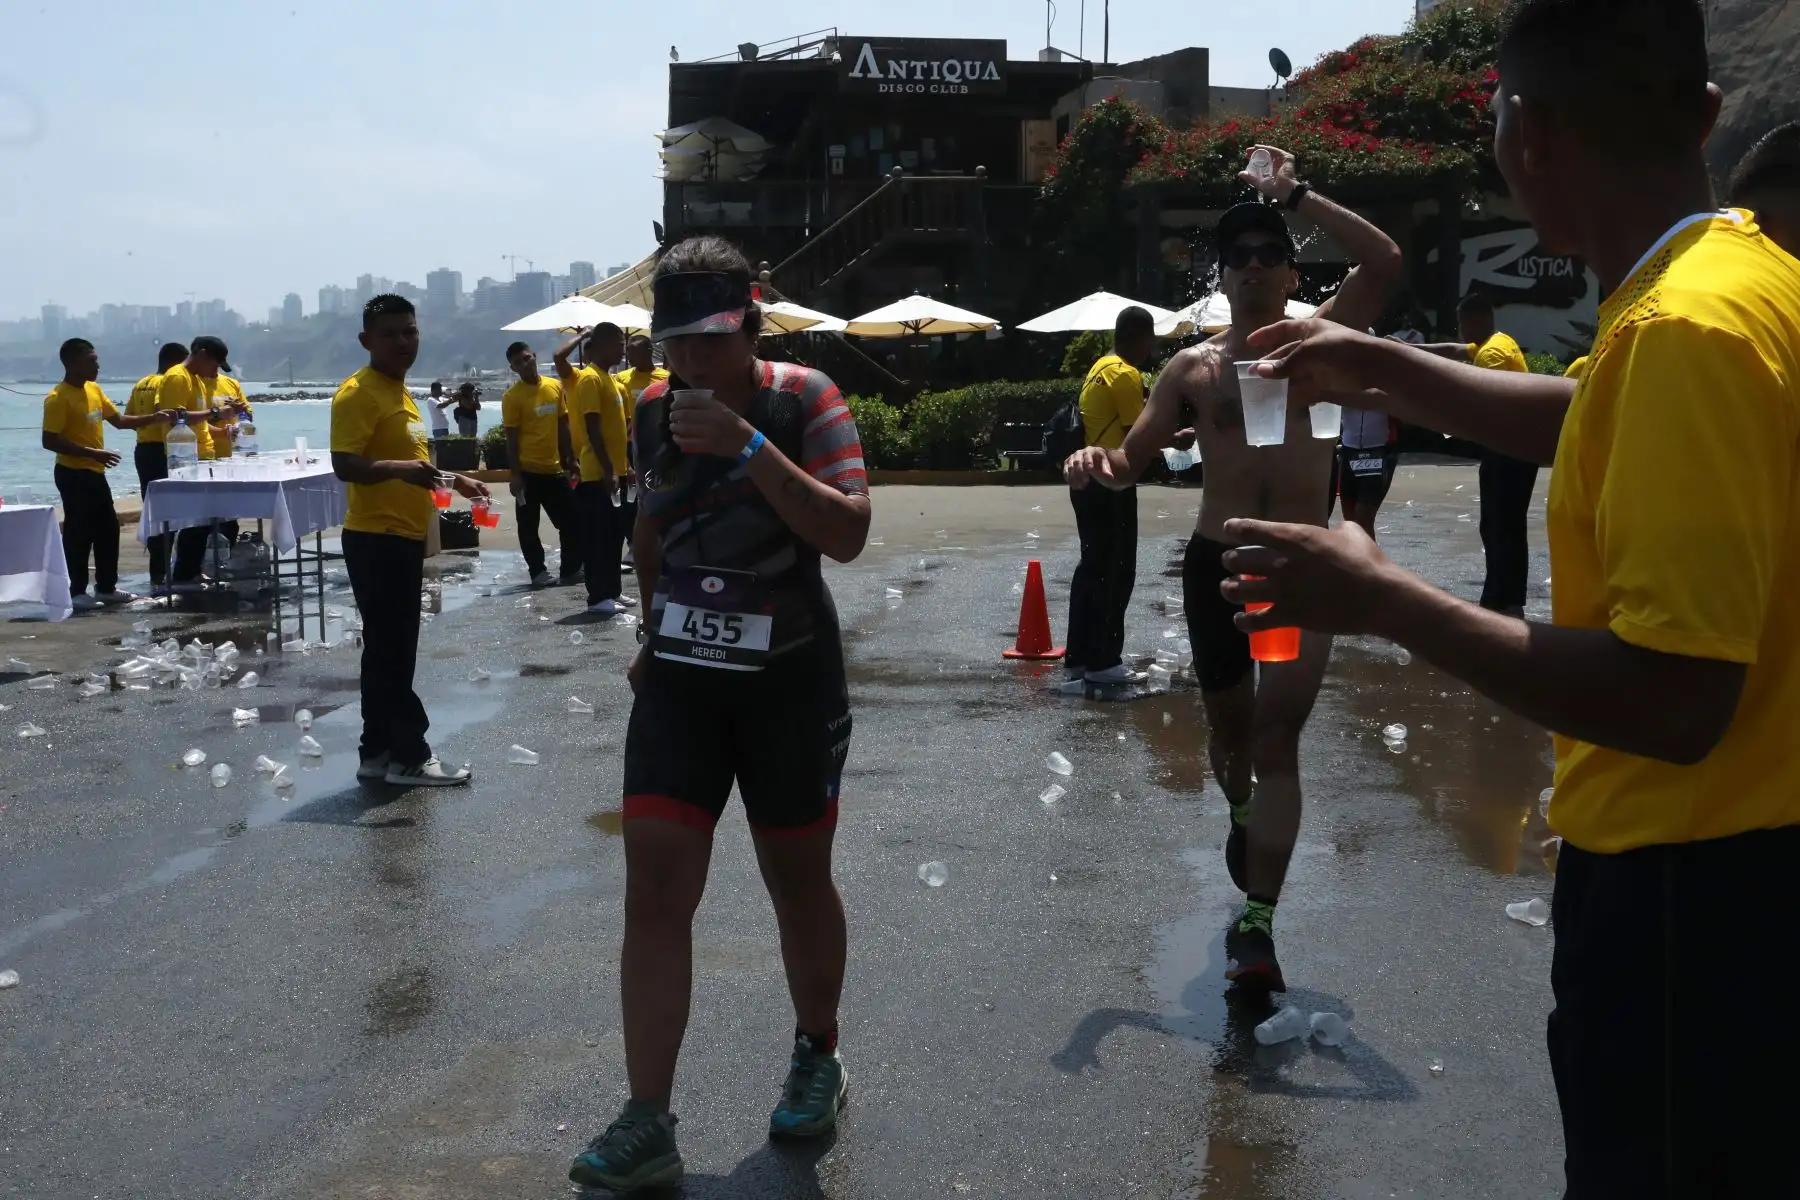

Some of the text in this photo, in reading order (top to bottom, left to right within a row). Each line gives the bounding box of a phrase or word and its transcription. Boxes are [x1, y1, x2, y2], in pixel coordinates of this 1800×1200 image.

[848, 43, 1001, 83] ANTIQUA
[879, 84, 969, 94] DISCO CLUB
[1459, 228, 1574, 298] RUSTICA
[681, 610, 743, 645] 455
[691, 645, 727, 660] HEREDI
